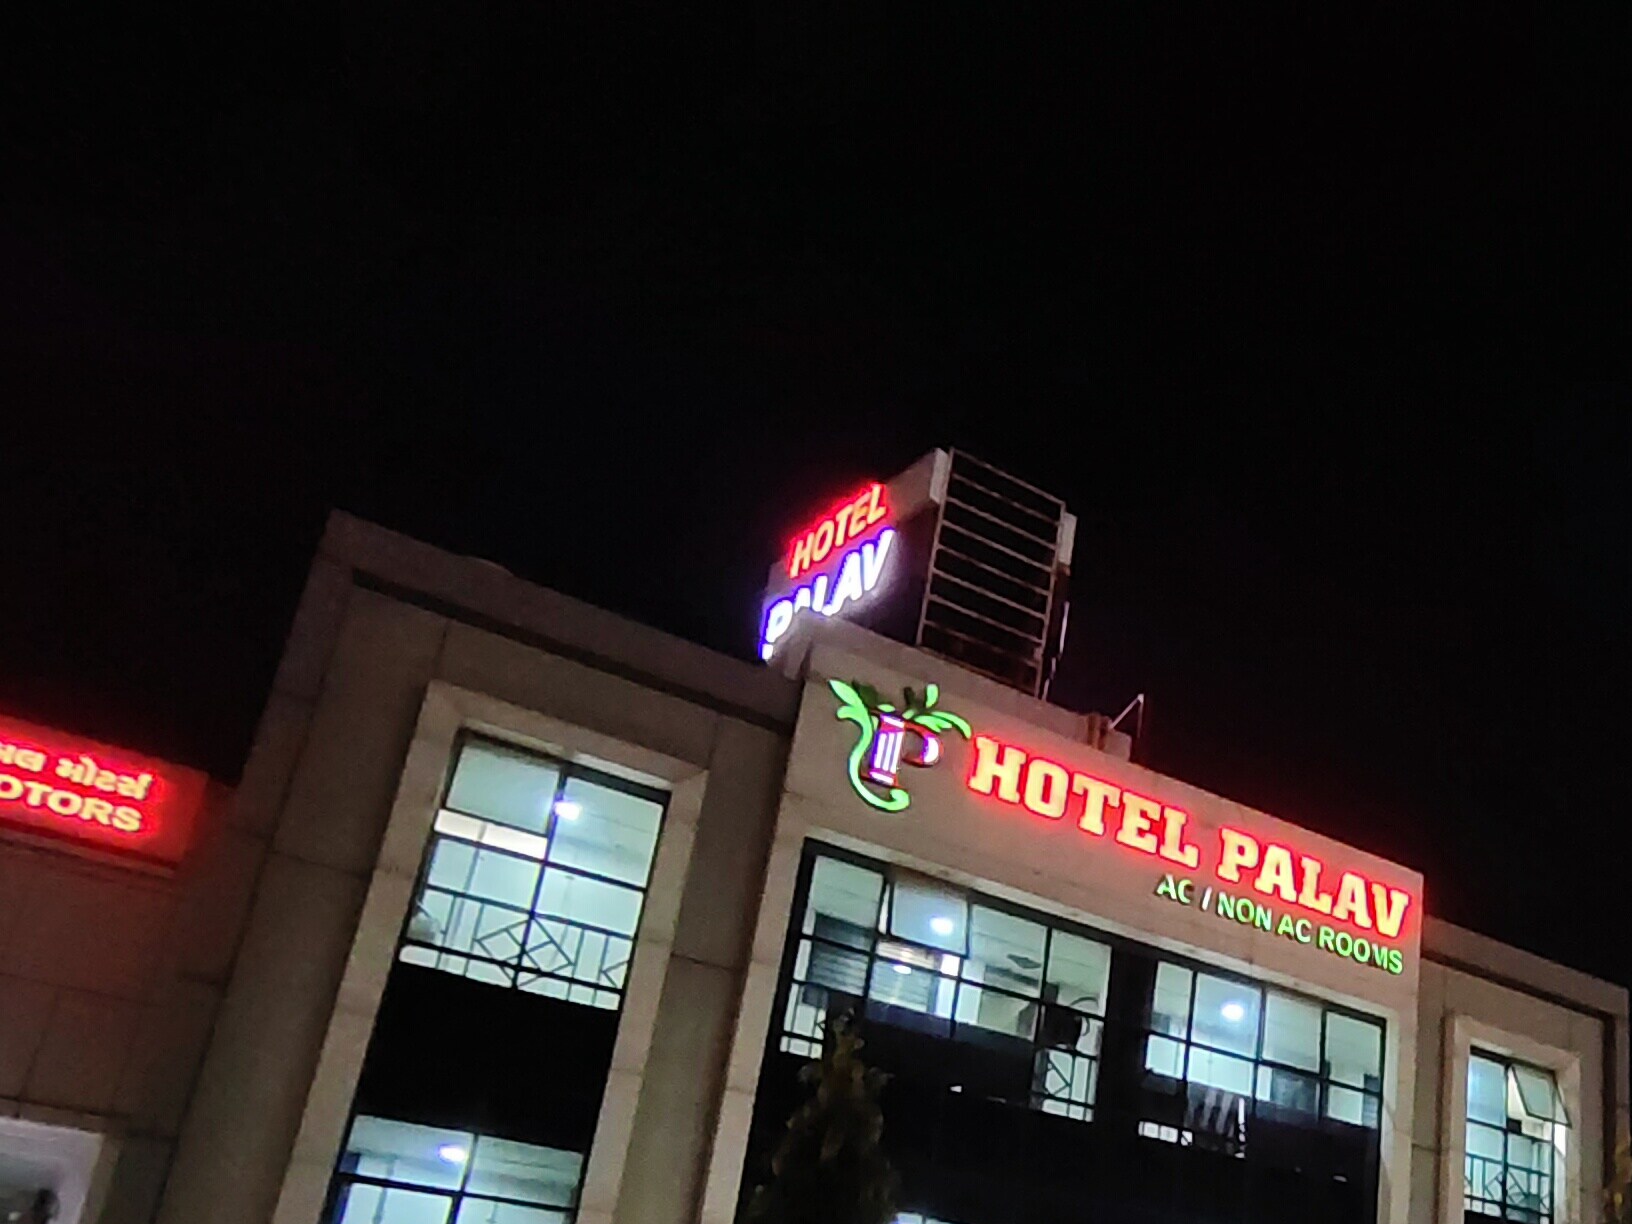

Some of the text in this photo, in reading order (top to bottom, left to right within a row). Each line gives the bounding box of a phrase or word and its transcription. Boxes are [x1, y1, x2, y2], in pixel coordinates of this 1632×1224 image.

[788, 482, 888, 580] HOTEL
[967, 735, 1411, 939] HOTEL PALAV
[1156, 873, 1194, 904] AC
[1217, 891, 1273, 932] NON
[1277, 914, 1312, 943] AC
[1317, 925, 1403, 974] ROOMS
